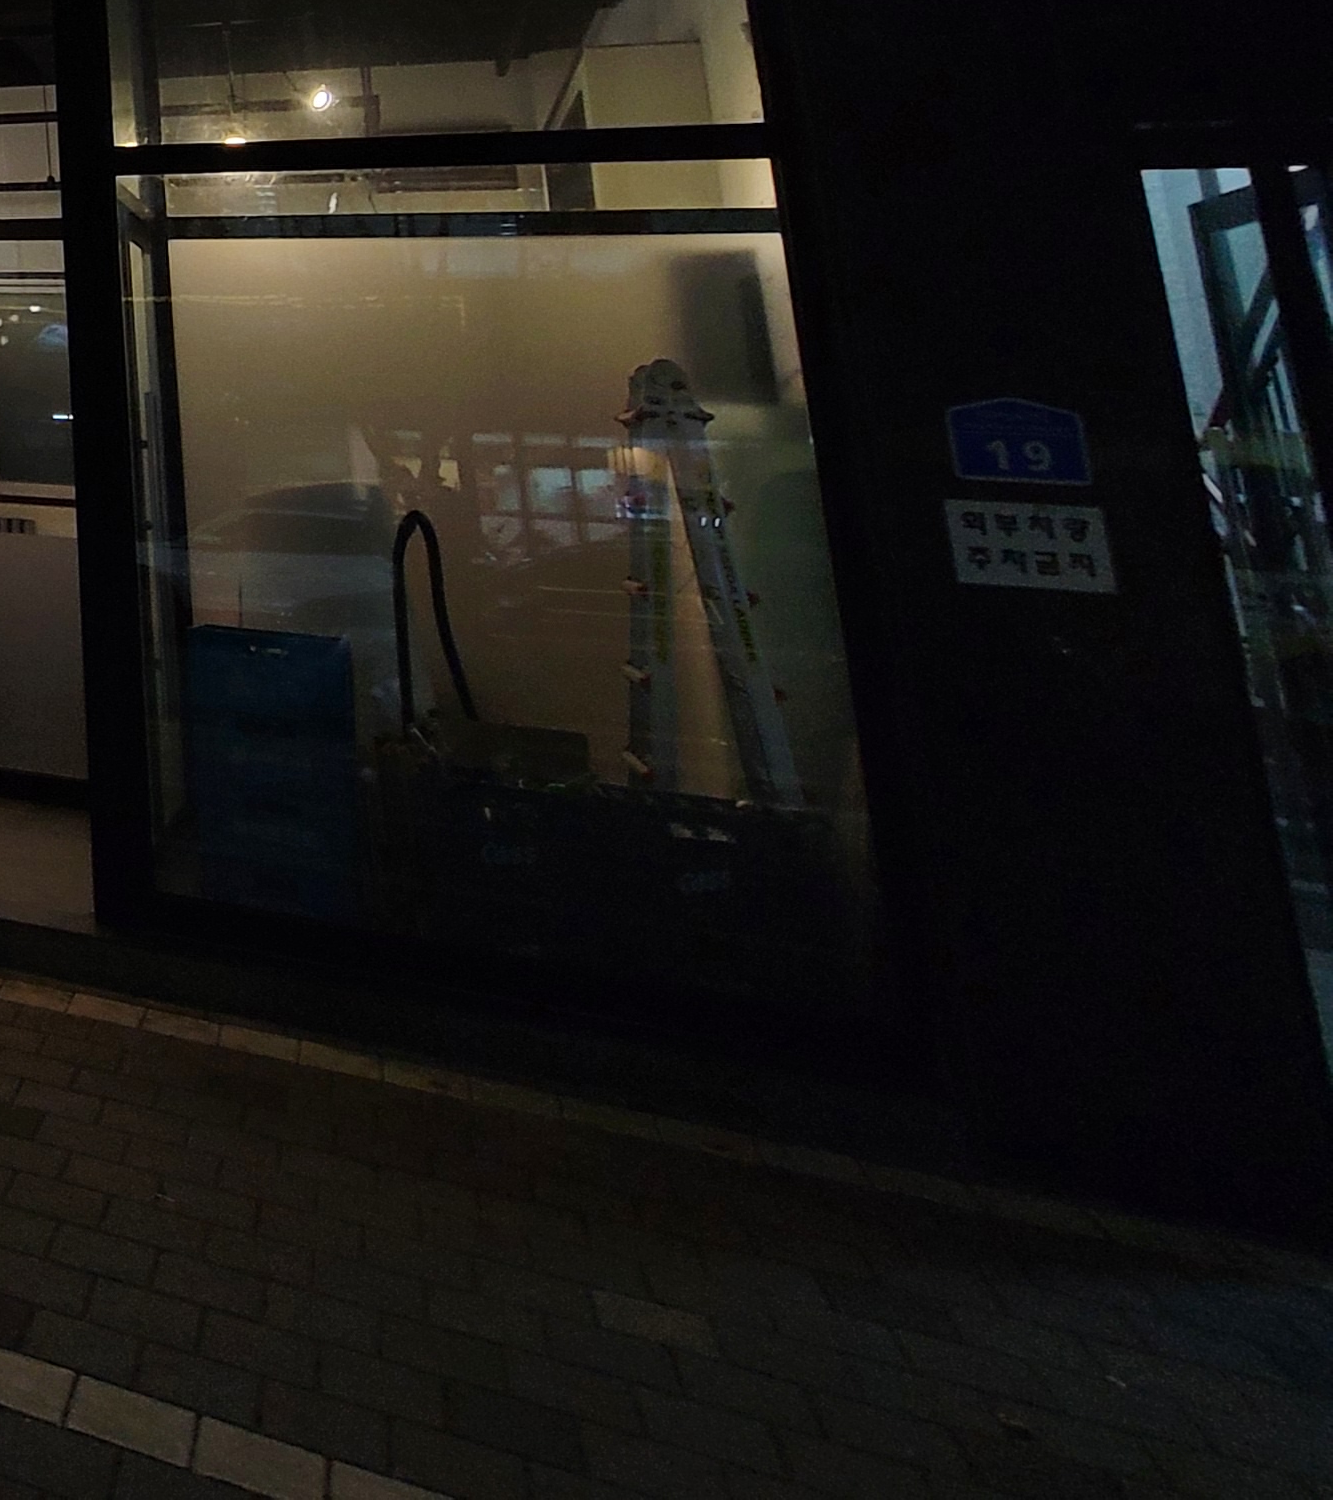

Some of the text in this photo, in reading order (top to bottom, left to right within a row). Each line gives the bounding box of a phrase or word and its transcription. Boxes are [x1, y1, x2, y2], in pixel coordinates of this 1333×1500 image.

[986, 439, 1054, 472] 19
[960, 511, 1091, 543] 외부차량
[967, 546, 1097, 578] 주차금지
